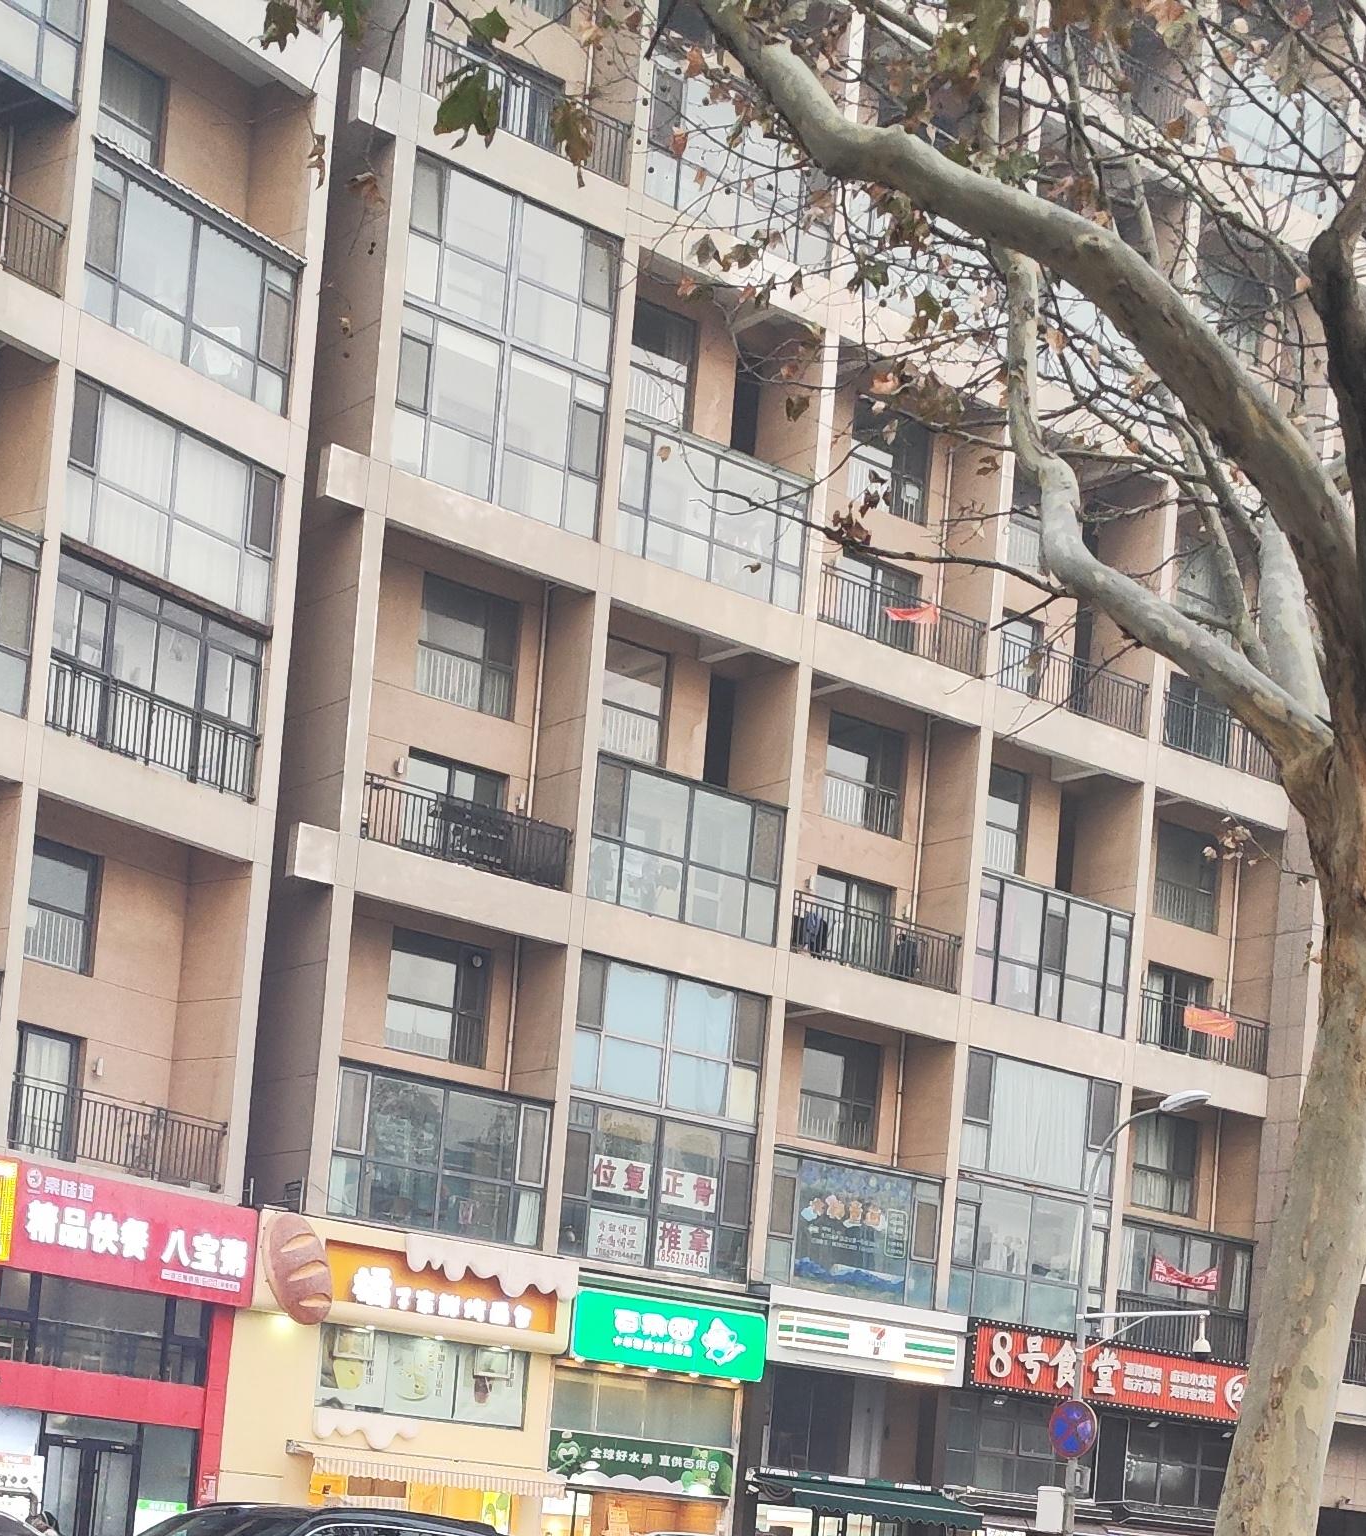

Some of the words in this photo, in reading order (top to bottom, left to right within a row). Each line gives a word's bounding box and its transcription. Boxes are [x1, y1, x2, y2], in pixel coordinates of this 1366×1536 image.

[661, 1170, 715, 1207] 正骨
[24, 1199, 150, 1262] 精品快餐
[160, 1229, 248, 1277] 八宝粥
[658, 1221, 711, 1257] 推拿
[656, 1251, 708, 1269] 18562784431
[989, 1331, 1121, 1396] 8号食堂
[590, 1446, 653, 1466] 全球好水果
[658, 1454, 720, 1473] 直供百果园
